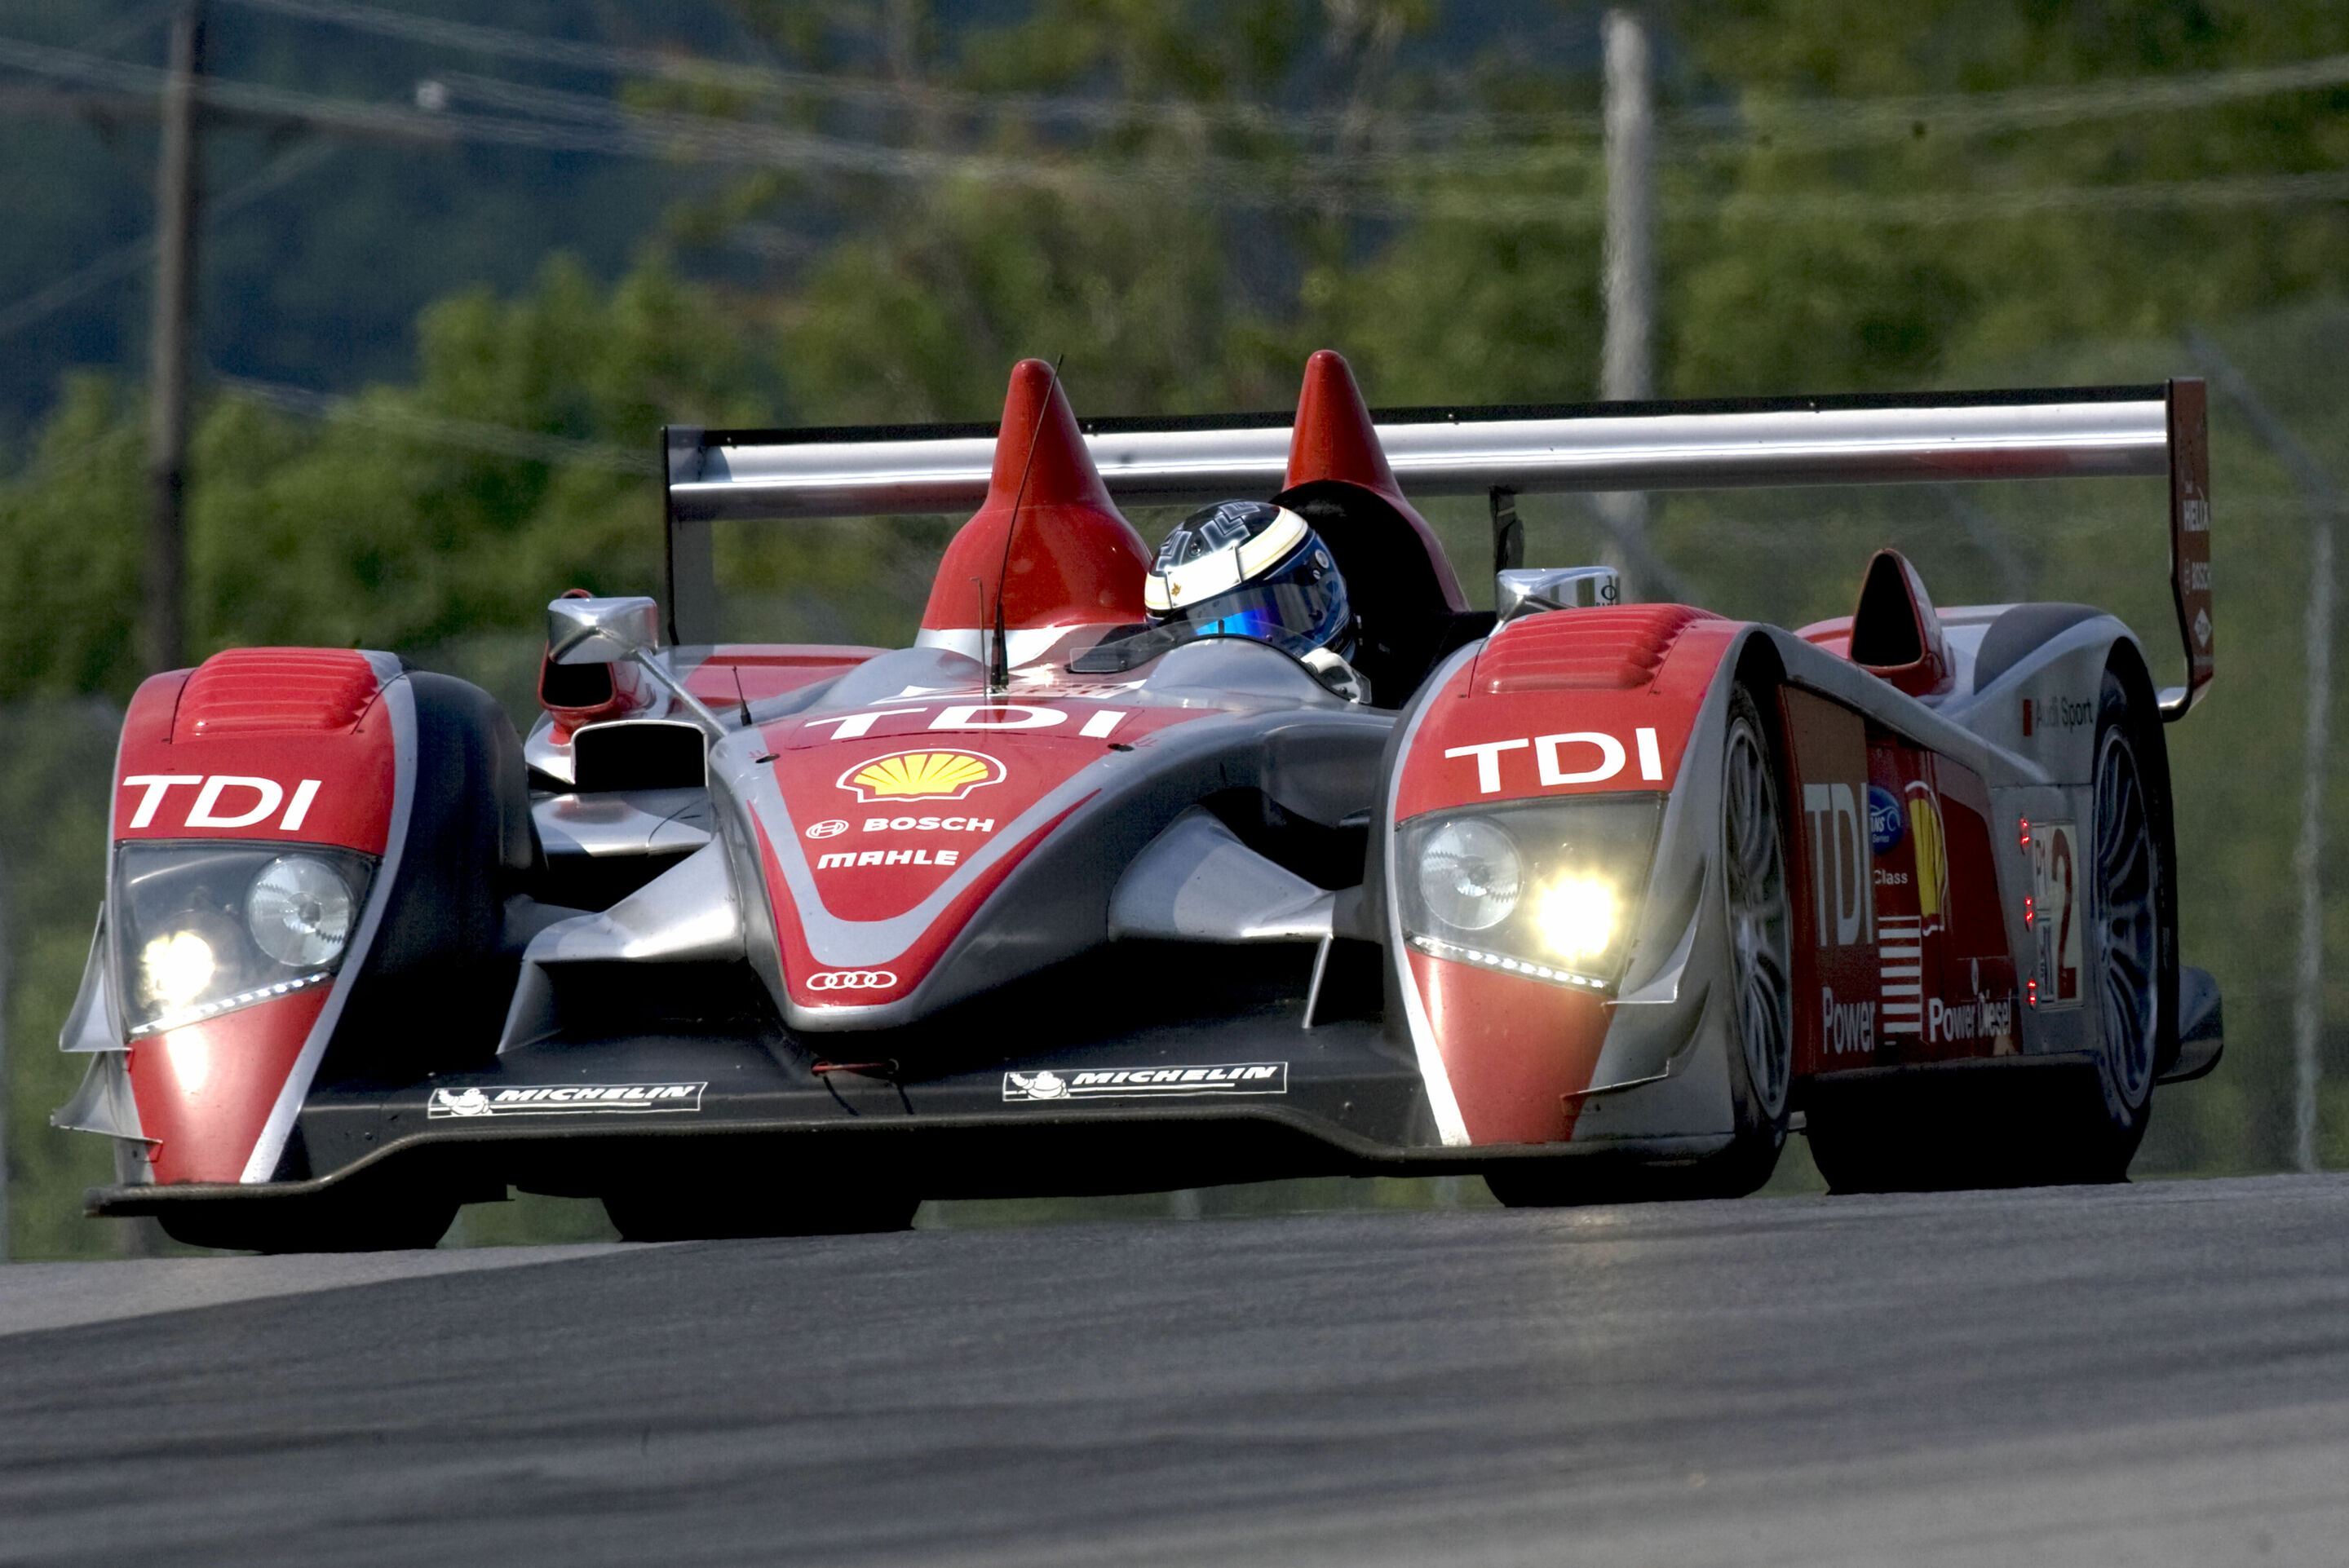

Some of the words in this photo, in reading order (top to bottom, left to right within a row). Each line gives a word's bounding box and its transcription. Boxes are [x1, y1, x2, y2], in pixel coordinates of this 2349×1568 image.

[805, 704, 1126, 739] TDI
[2062, 696, 2093, 733] Sport
[1444, 727, 1663, 793] TDI
[122, 775, 322, 831] TDI
[862, 816, 995, 833] BOSCH
[817, 850, 959, 869] MAHLE
[1804, 782, 1874, 947] TDI
[2051, 828, 2077, 999] 2
[1822, 986, 1876, 1055] Power
[1929, 996, 1976, 1043] Power
[1978, 987, 2013, 1038] Diesel
[495, 1085, 696, 1103] MICHELIN
[1072, 1066, 1278, 1085] MICHELIN
